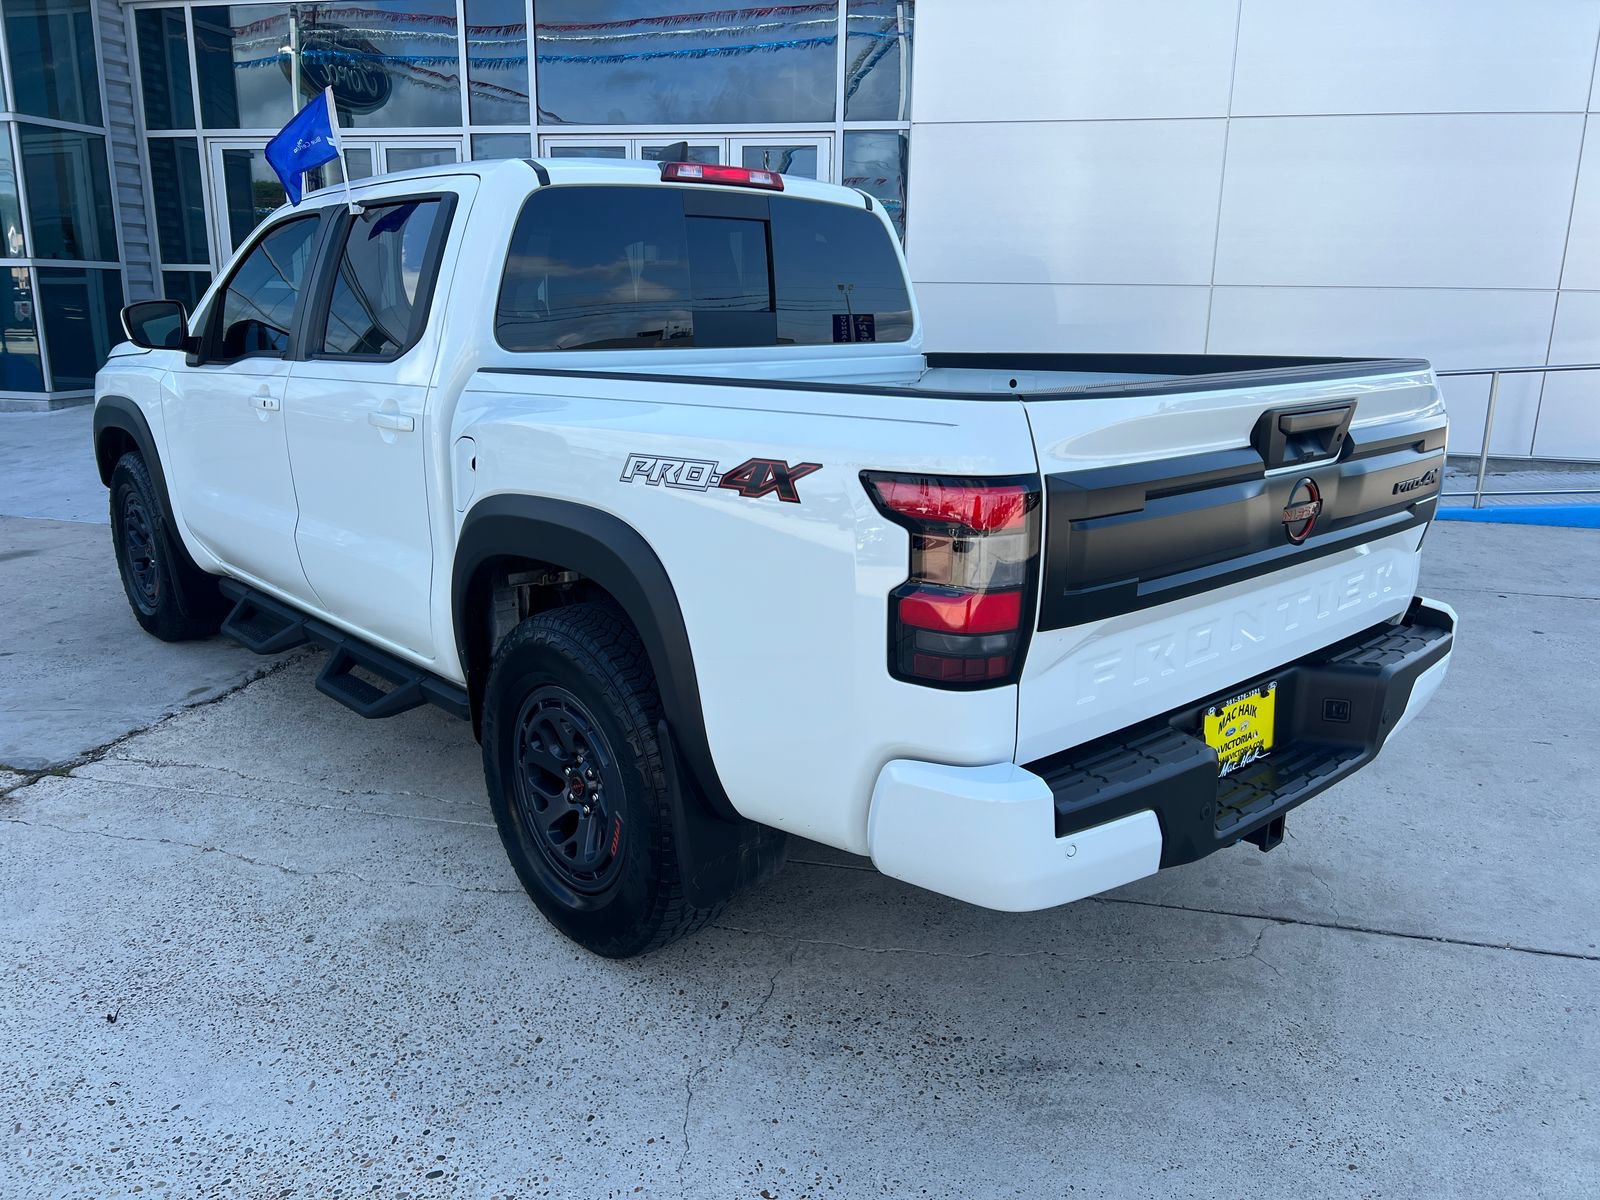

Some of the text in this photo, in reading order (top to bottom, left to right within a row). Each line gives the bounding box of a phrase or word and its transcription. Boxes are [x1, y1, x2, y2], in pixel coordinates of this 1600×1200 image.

[1076, 558, 1394, 704] FRONTIER
[1218, 707, 1237, 735] MAC
[1238, 704, 1258, 718] HAIK
